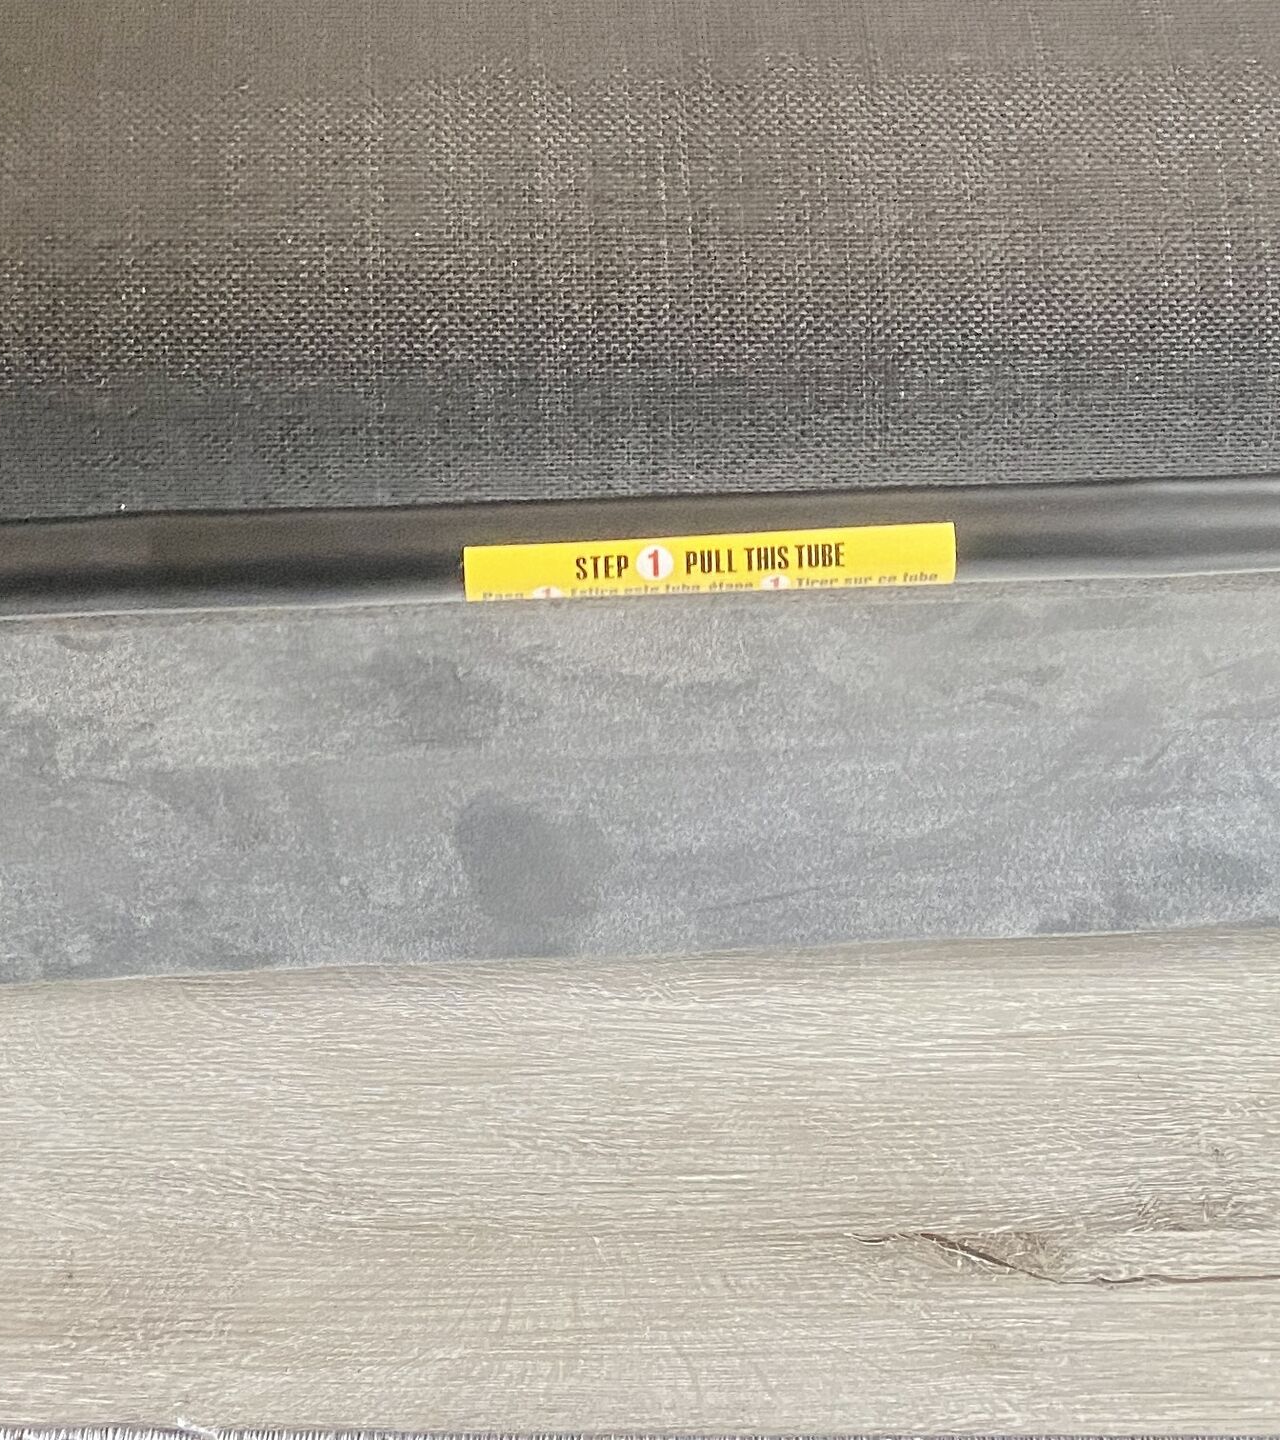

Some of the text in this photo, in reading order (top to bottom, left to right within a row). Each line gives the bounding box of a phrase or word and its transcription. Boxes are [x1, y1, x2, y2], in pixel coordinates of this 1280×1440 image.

[576, 542, 846, 580] STEP 1 PULL THIS TUBE
[796, 575, 838, 587] Tirer
[878, 572, 896, 583] ce
[904, 570, 940, 582] tube
